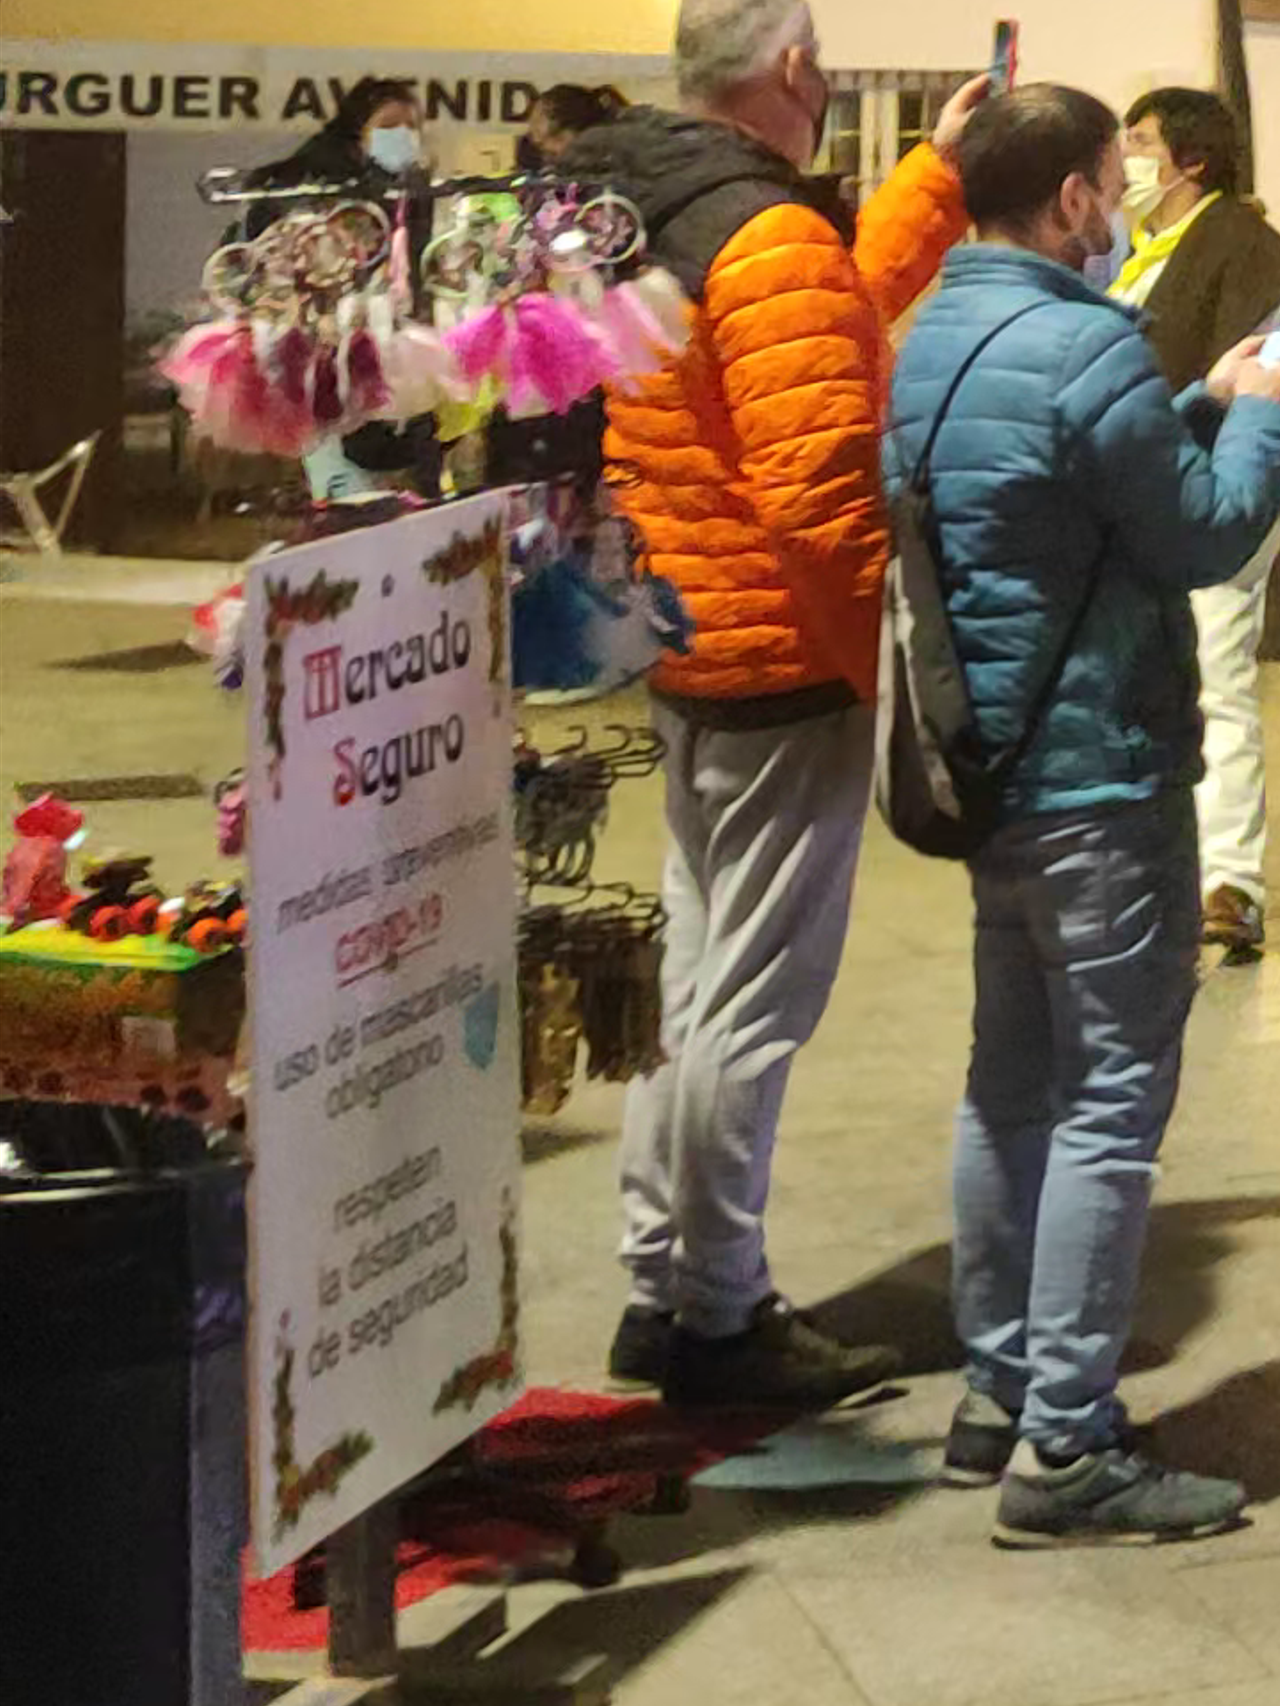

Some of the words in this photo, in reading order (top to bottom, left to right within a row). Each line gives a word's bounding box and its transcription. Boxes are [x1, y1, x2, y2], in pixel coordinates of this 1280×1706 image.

[0, 70, 261, 119] RGUER
[302, 610, 471, 721] Mercado
[333, 712, 465, 807] Seguro
[274, 1042, 320, 1092] uso
[325, 1024, 356, 1067] de
[360, 962, 484, 1048] mascarillas
[324, 1033, 445, 1120] obligatorio
[333, 1145, 442, 1233] respeten
[318, 1263, 342, 1307] la
[348, 1197, 457, 1293] distancia
[308, 1326, 342, 1379] de
[348, 1241, 470, 1354] seguridad
